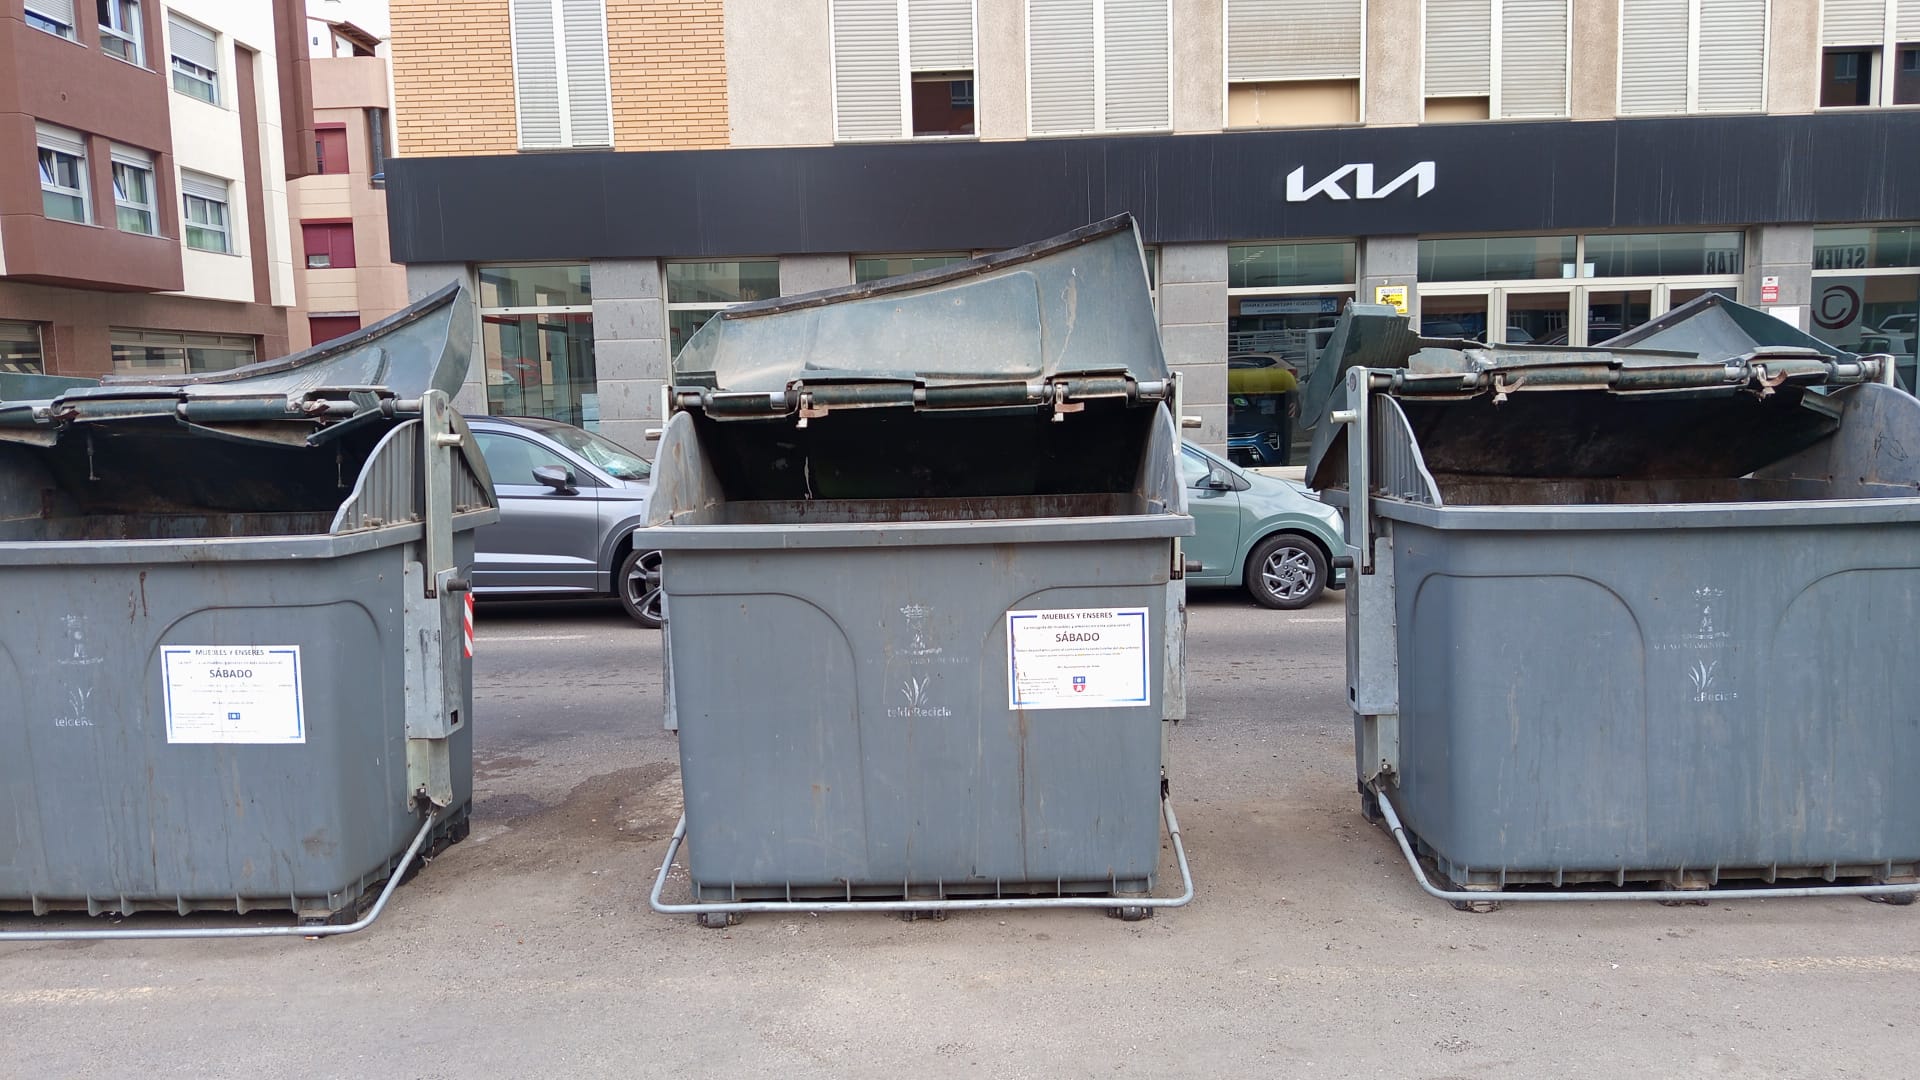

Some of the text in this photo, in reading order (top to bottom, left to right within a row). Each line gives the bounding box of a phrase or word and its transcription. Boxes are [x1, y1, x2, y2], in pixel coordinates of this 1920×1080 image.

[1286, 160, 1436, 202] KIA
[1041, 612, 1075, 620] MUEBLES
[1082, 611, 1113, 619] ENSERES
[1055, 631, 1100, 643] SÁBADO
[209, 667, 253, 678] SÁBADO
